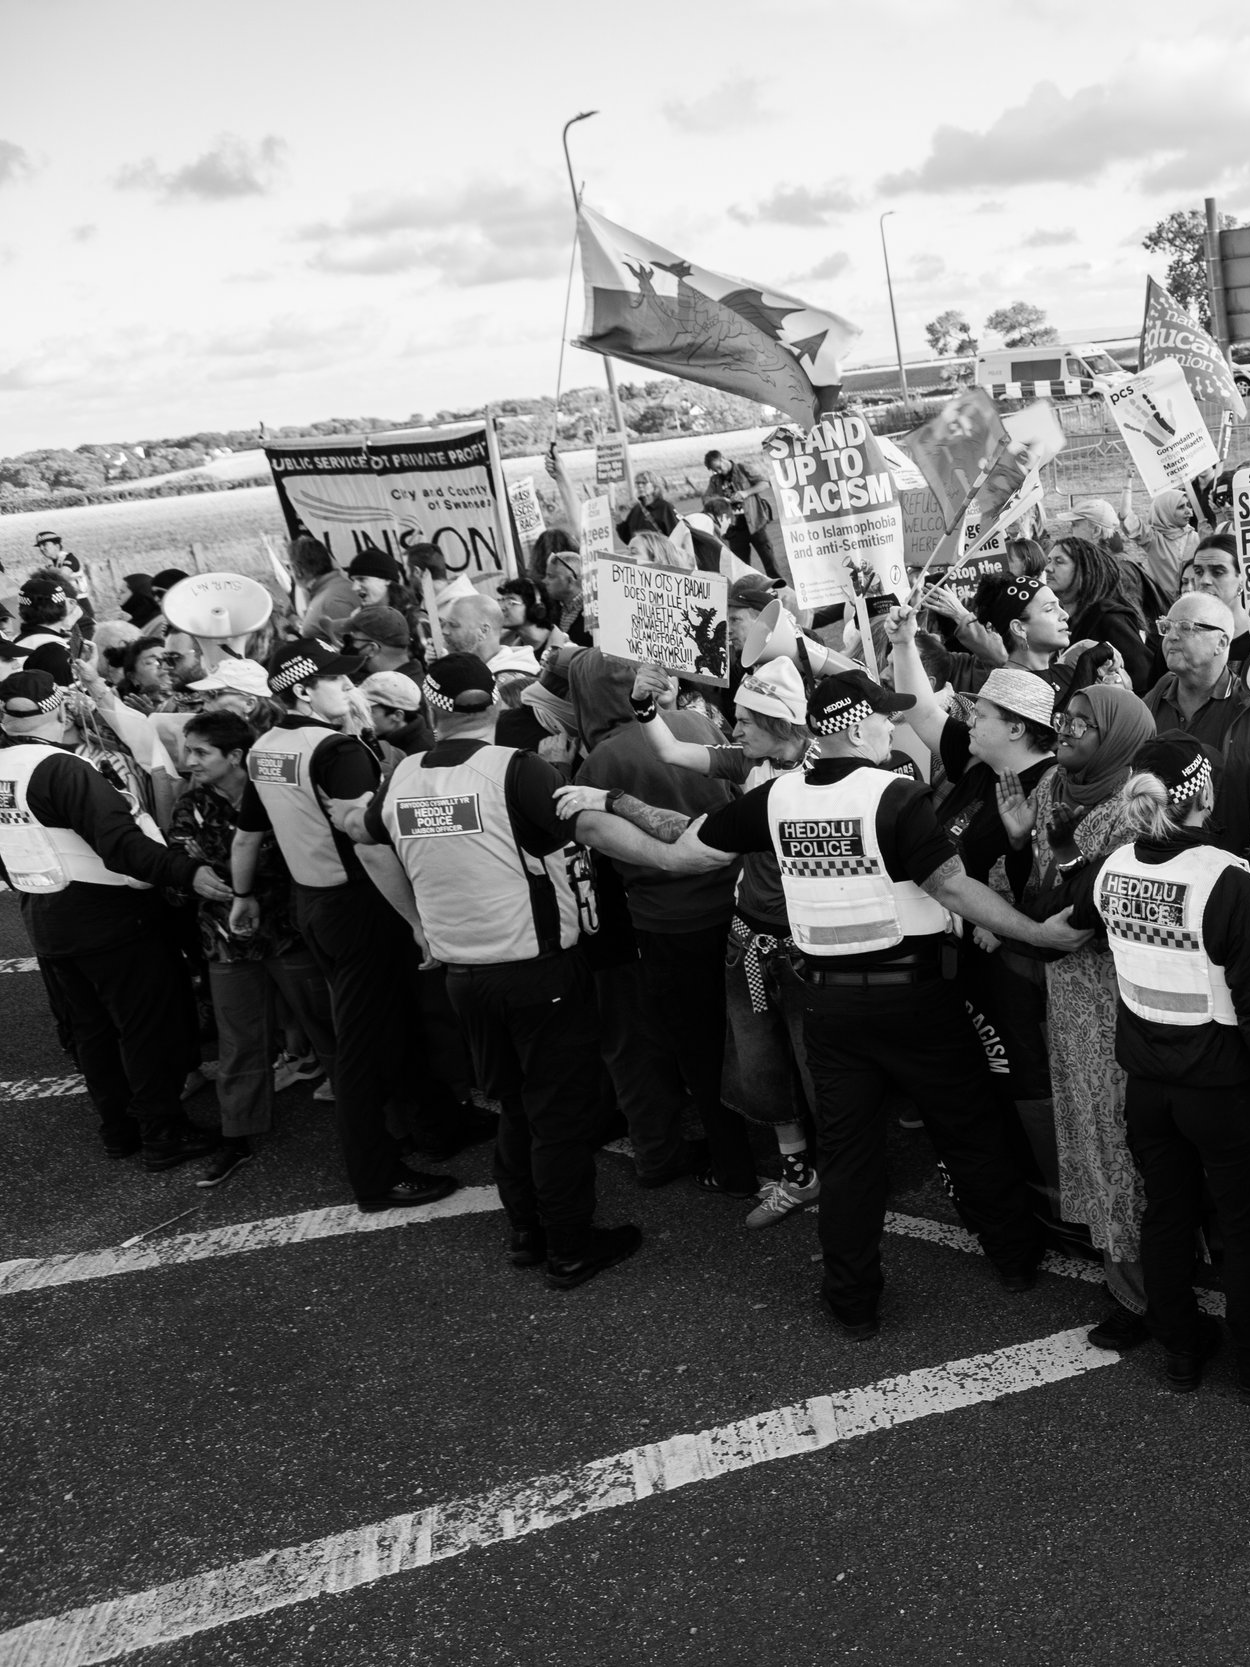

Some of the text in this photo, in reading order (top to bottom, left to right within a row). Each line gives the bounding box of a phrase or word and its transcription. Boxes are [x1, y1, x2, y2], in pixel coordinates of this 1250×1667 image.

[1110, 385, 1134, 405] pcs
[392, 451, 447, 467] PRIVATE
[1163, 455, 1186, 471] March
[772, 457, 816, 489] UP
[821, 448, 864, 481] TO
[1166, 463, 1189, 477] racism
[780, 472, 893, 519] RACISM
[790, 515, 896, 544] No to Islamophobia
[793, 532, 894, 560] and anti-Semitism
[947, 560, 1003, 580] Stop the
[612, 564, 635, 585] BYTH
[638, 570, 652, 588] YN
[655, 573, 673, 592] OTS
[675, 577, 682, 596] Y
[624, 585, 646, 602] DOES
[649, 591, 664, 605] DIM
[667, 594, 682, 609] LLE
[672, 622, 683, 635] AC
[631, 628, 685, 648] ISLAMOFFOBIA
[626, 639, 643, 655] YNG
[823, 697, 852, 714] HEDDLU
[257, 758, 283, 768] HEDDLU
[258, 767, 282, 776] POLICE
[1181, 754, 1203, 777] HEDDLU
[414, 806, 454, 818] HEDDLU
[417, 816, 453, 827] POLICE
[436, 825, 463, 833] OFFICER
[783, 822, 853, 838] HEDDLU
[790, 841, 852, 857] POLICE
[1106, 876, 1178, 901] HEDDLU
[1109, 896, 1171, 922] POLICE
